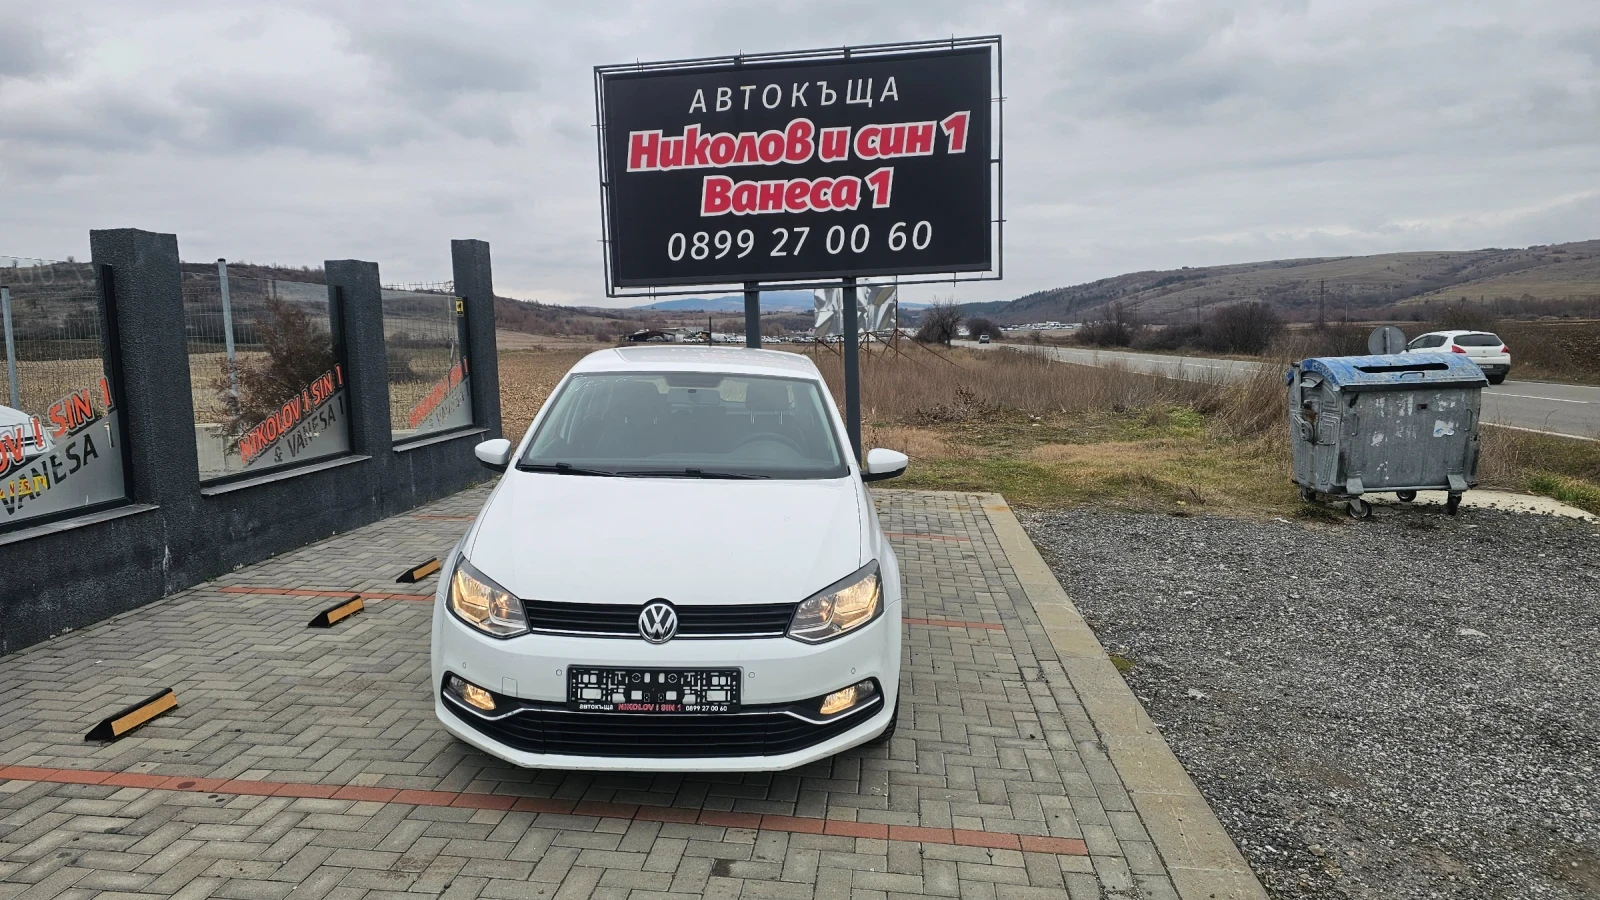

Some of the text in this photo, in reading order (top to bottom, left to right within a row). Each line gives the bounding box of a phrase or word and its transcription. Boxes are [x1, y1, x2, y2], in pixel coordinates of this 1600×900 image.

[689, 76, 899, 114] АВТОКЪЩА
[627, 110, 971, 172] Николов и син 1
[700, 166, 895, 217] Ванеса 1
[668, 220, 933, 261] 0899 27 00 60
[48, 387, 95, 440] SIN
[239, 395, 300, 464] NIKOLOV
[311, 371, 334, 406] SIN
[335, 363, 343, 387] 1
[287, 404, 336, 458] VANESA
[618, 703, 654, 711] NIKOLOV
